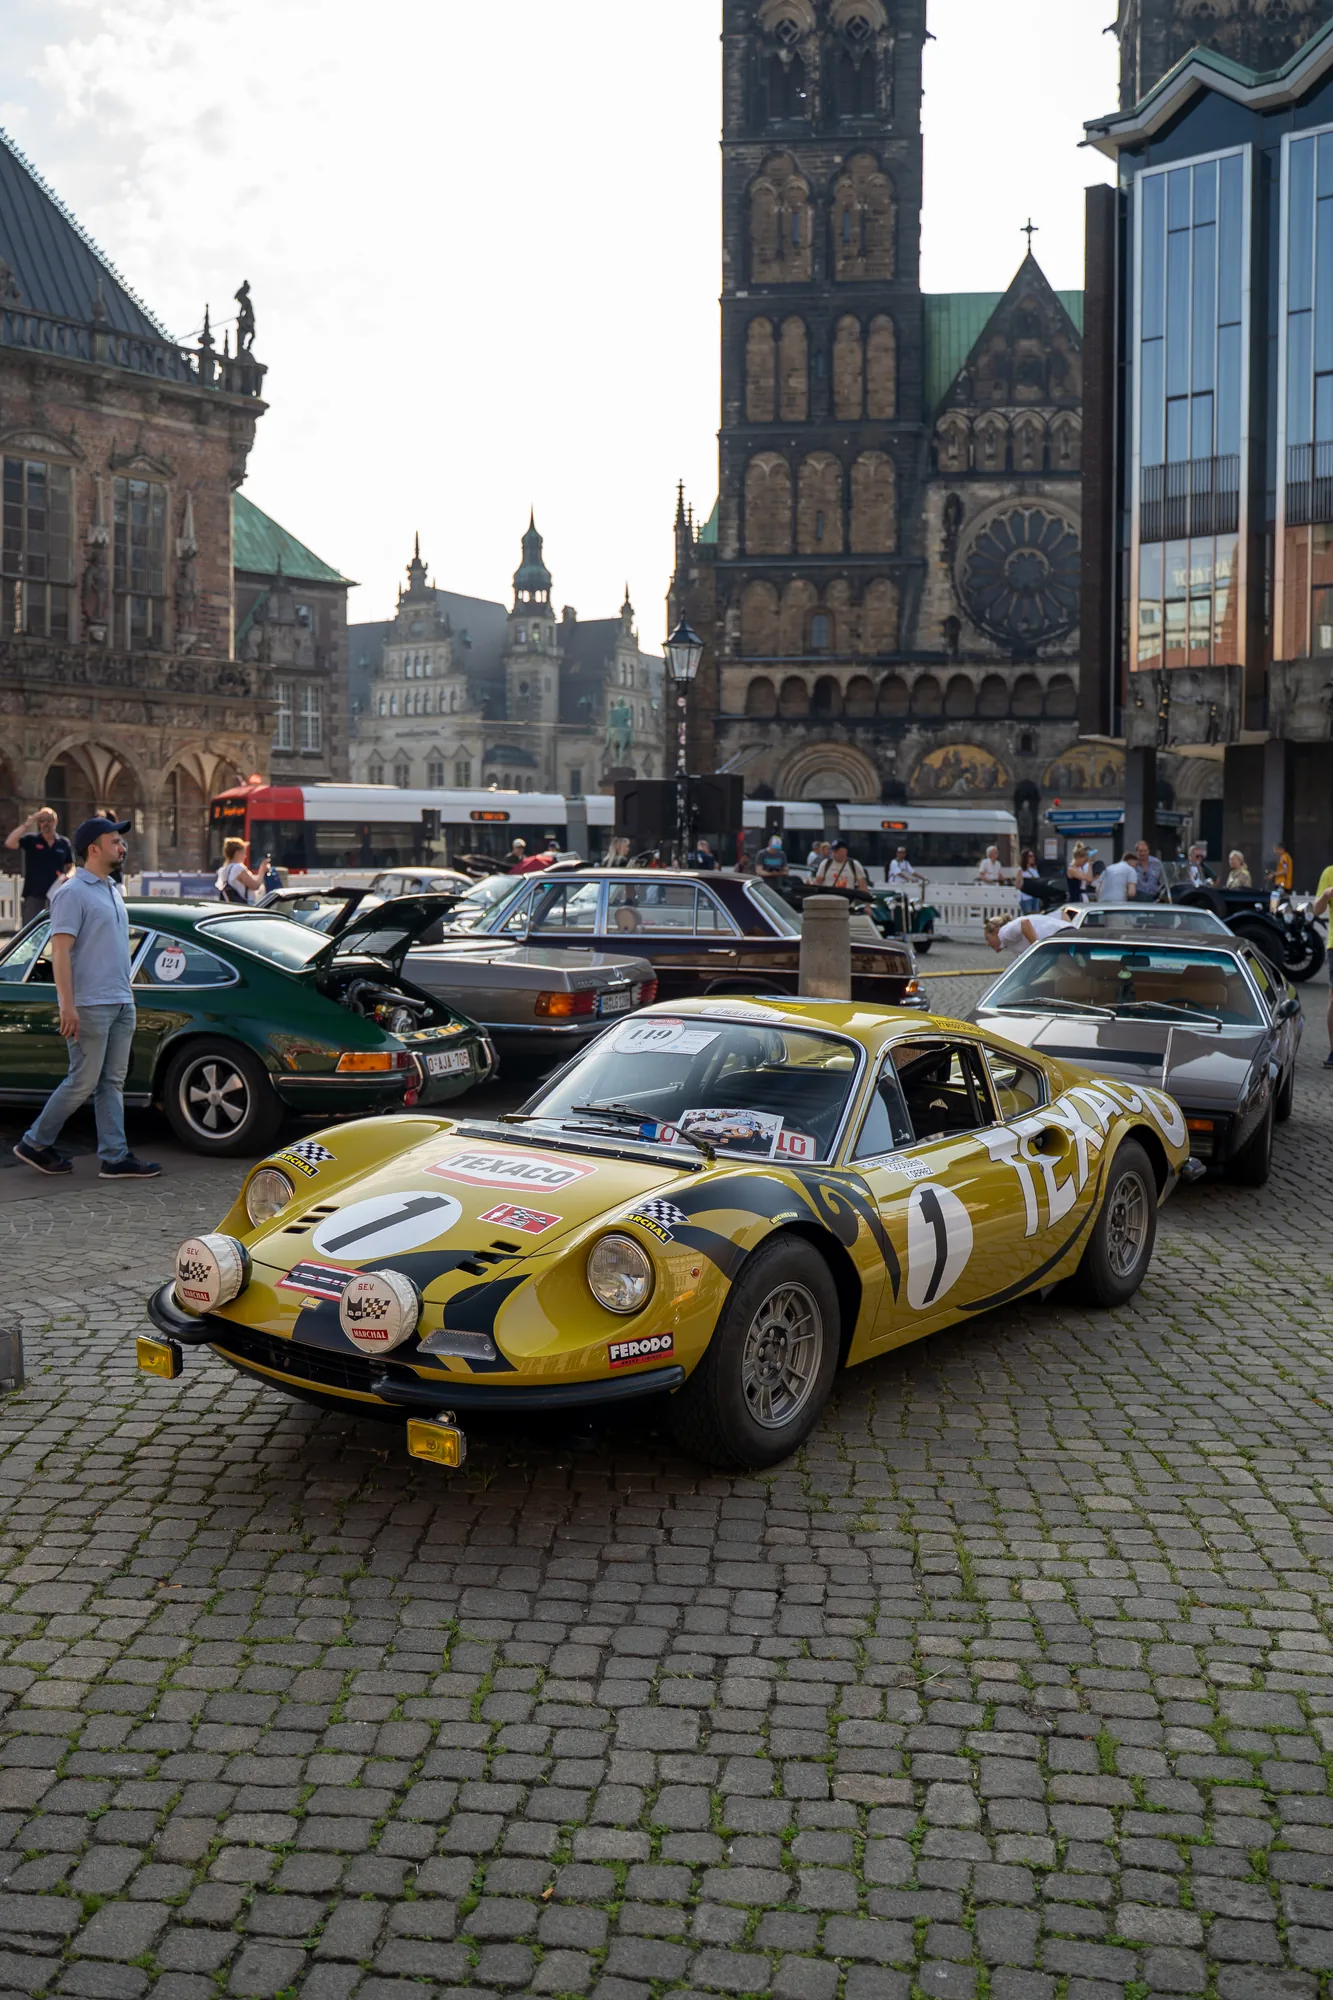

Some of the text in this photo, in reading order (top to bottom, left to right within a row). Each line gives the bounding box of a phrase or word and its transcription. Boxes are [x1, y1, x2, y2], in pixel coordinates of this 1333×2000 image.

[448, 1154, 576, 1183] TEXACO
[972, 1079, 1187, 1238] TEXACO
[321, 1196, 451, 1253] 1
[919, 1188, 948, 1304] 1
[353, 1329, 387, 1339] MARCHAL
[610, 1335, 672, 1360] FERODO
